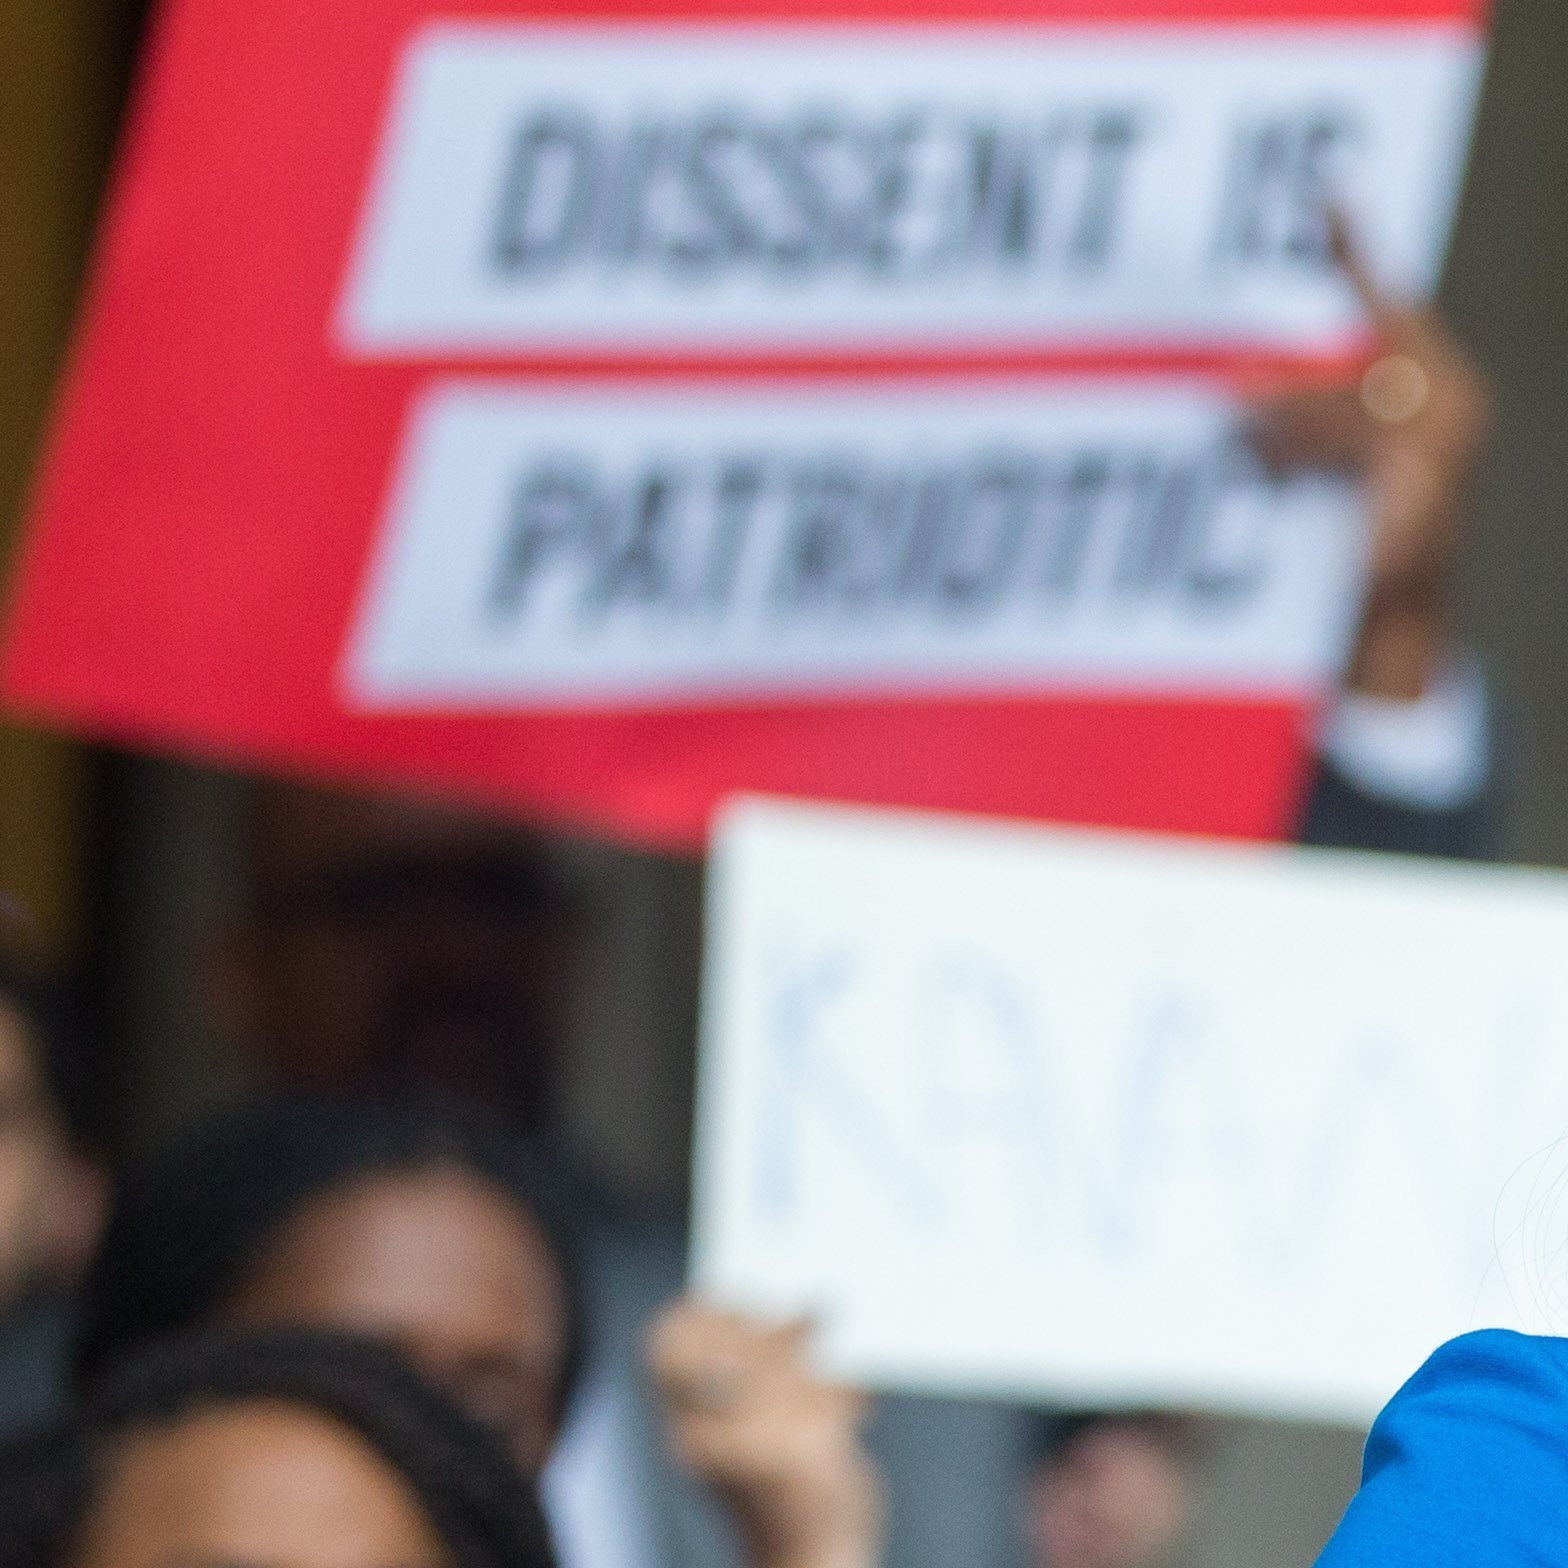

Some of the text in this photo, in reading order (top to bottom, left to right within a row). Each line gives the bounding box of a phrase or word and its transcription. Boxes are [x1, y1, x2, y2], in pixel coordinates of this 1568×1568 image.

[483, 90, 1368, 285] DISSENT IS
[483, 438, 1285, 635] PATRIOTIC
